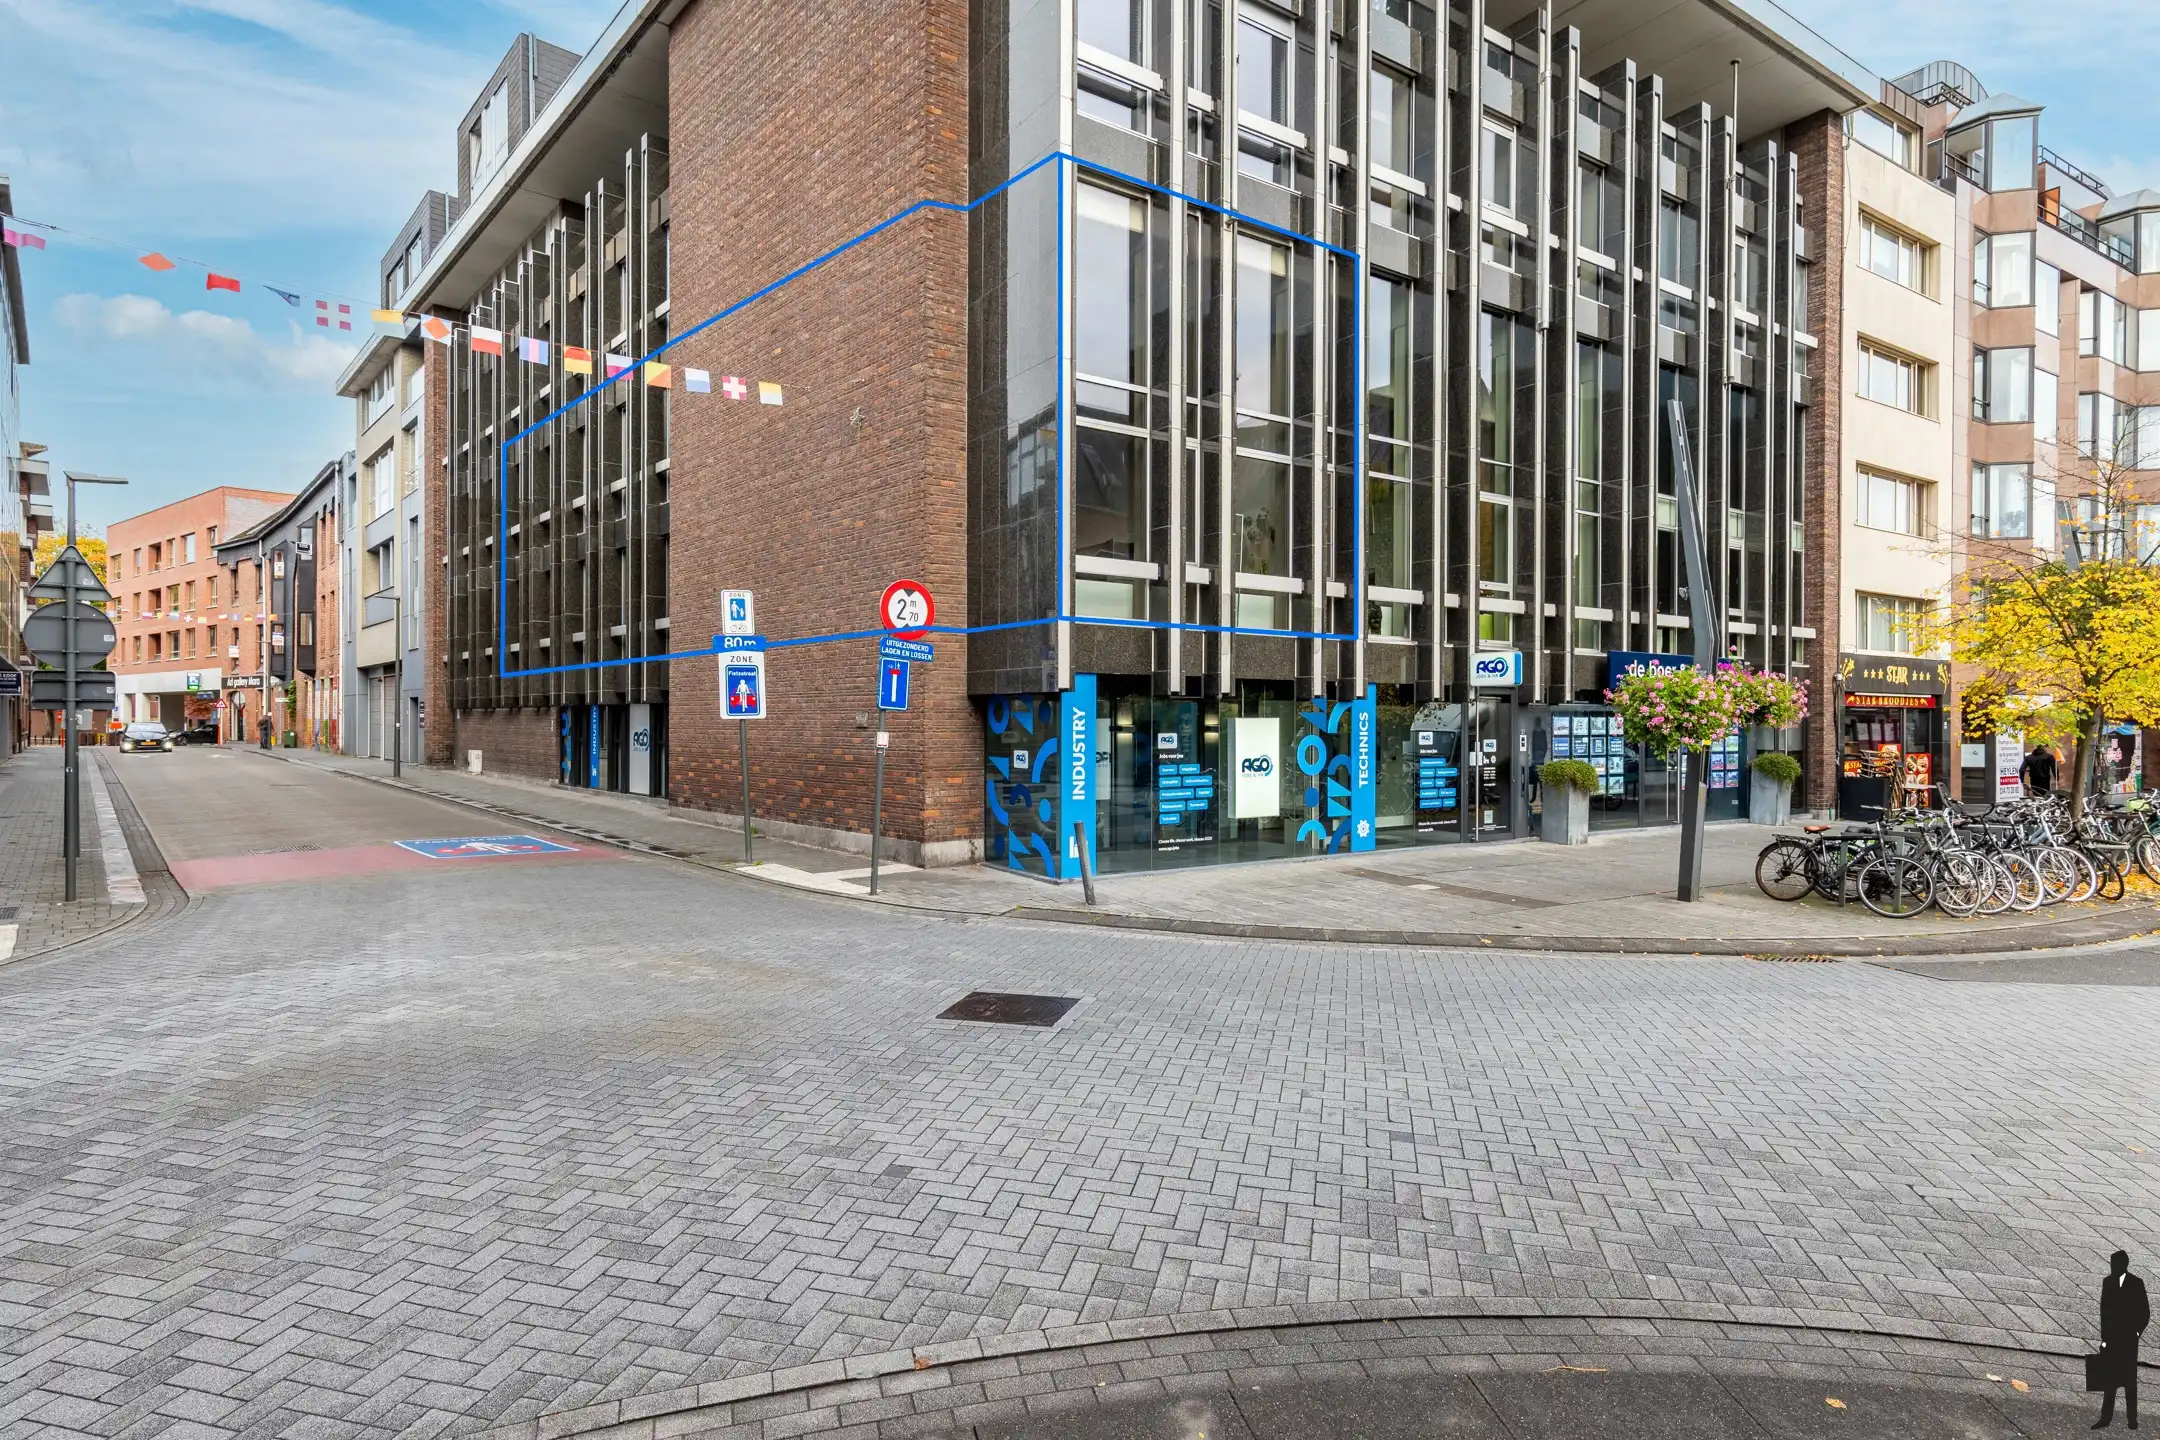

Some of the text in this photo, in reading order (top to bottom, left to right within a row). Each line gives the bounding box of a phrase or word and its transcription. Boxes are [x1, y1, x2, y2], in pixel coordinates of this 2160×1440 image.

[897, 598, 907, 621] 2
[909, 612, 919, 622] 70
[881, 646, 933, 661] LADEN EN LOSSEN
[886, 639, 930, 653] UITGEZONDERD
[730, 655, 753, 663] ZONE
[1476, 658, 1508, 676] AGO
[1886, 665, 1908, 686] STAR
[1855, 696, 1877, 705] STAR
[1072, 706, 1086, 801] INDUSTRY
[1358, 711, 1369, 789] TECHNICS
[1242, 756, 1272, 774] AGO
